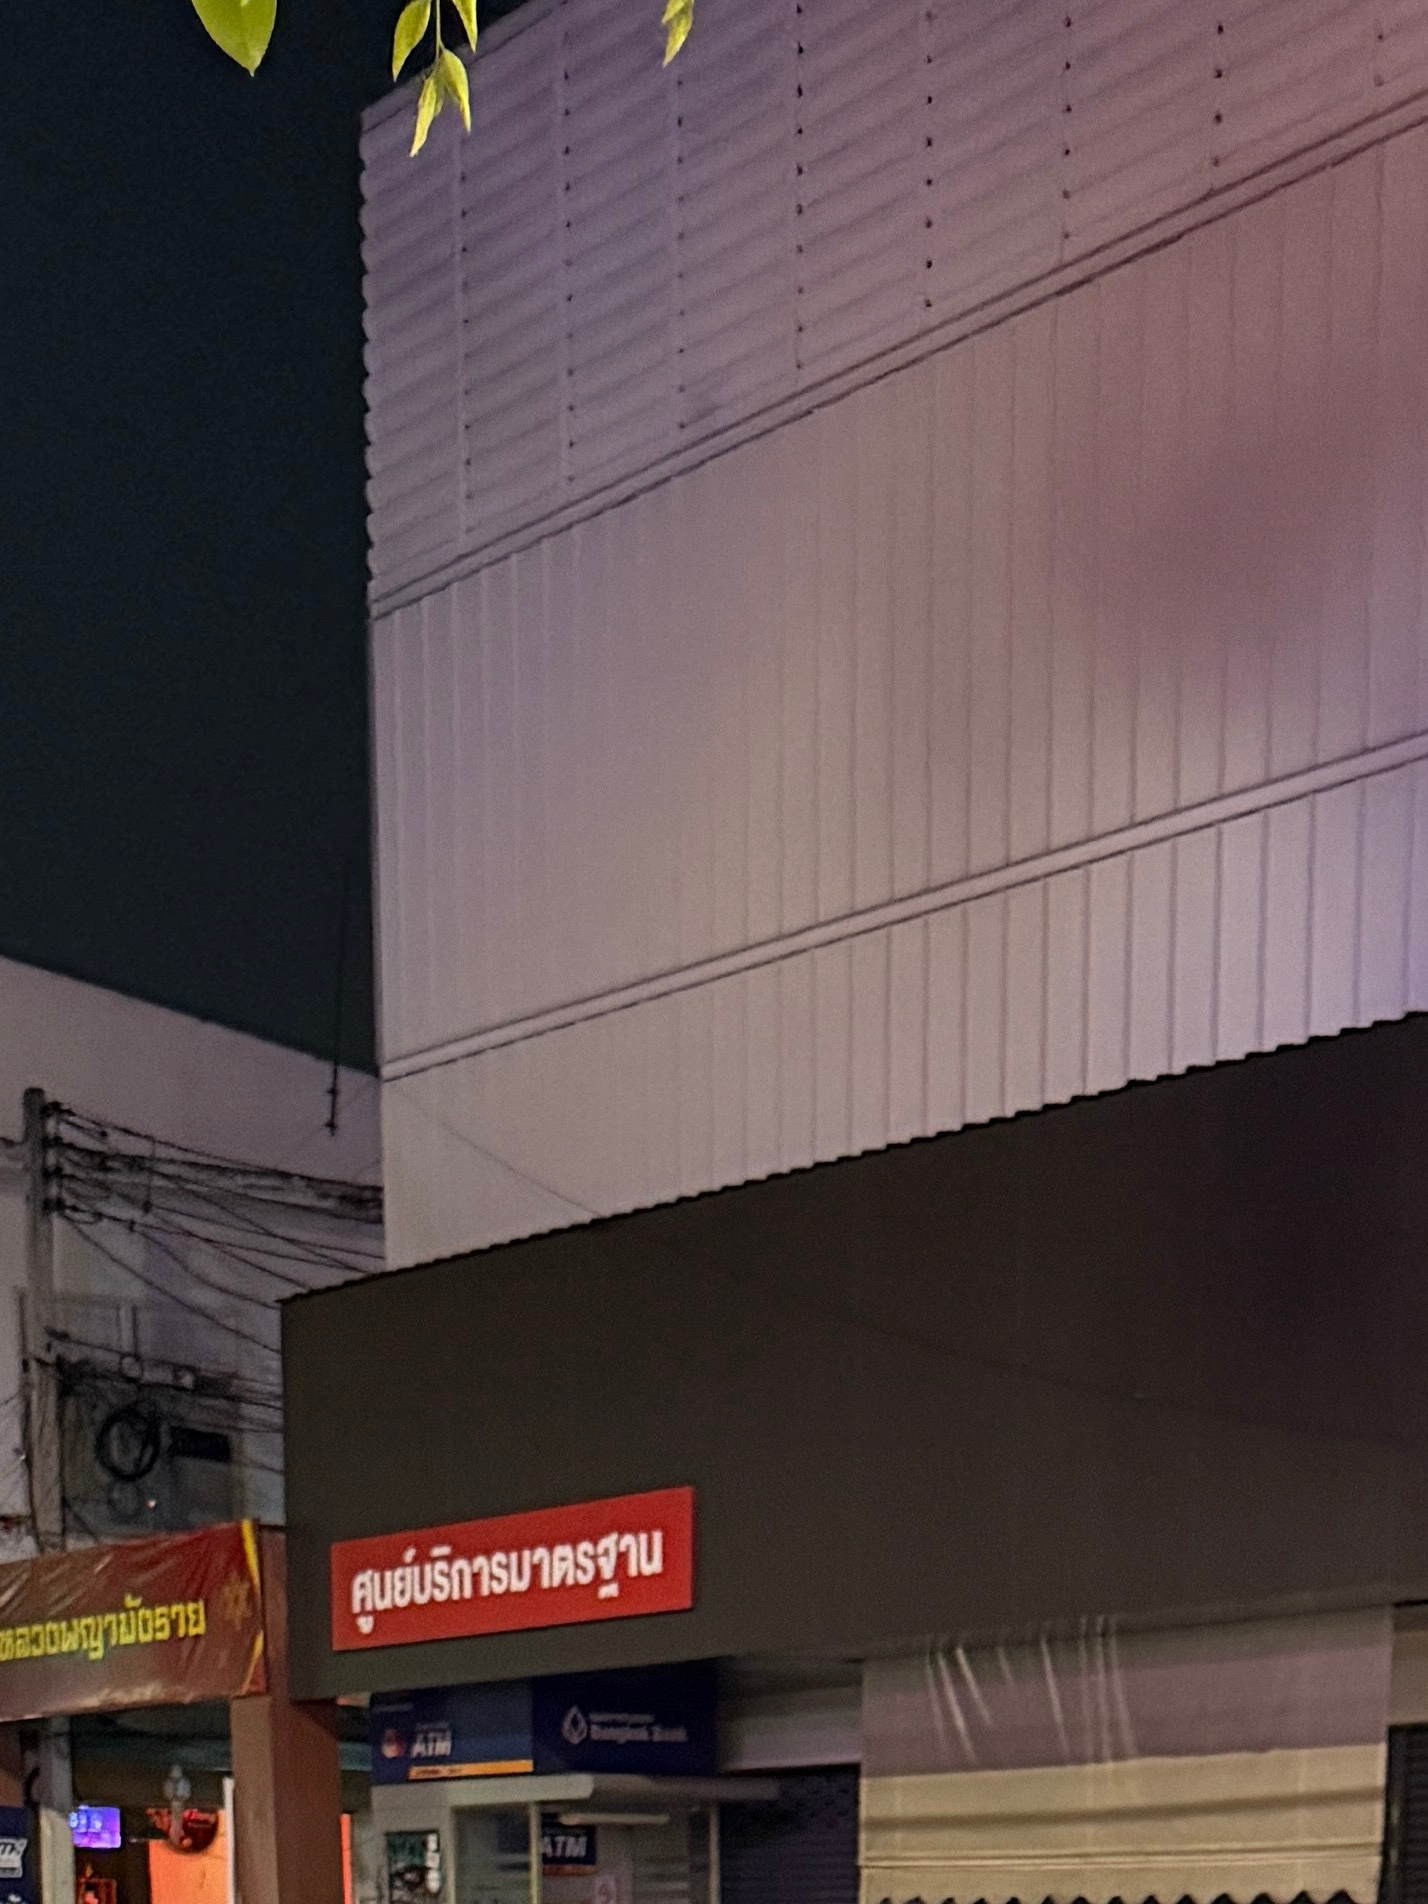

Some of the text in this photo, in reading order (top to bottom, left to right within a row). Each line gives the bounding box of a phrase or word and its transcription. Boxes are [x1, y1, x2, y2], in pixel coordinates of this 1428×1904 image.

[351, 1529, 664, 1635] ศูนย์บริการมาตรฐาน
[540, 1835, 588, 1858] ATM
